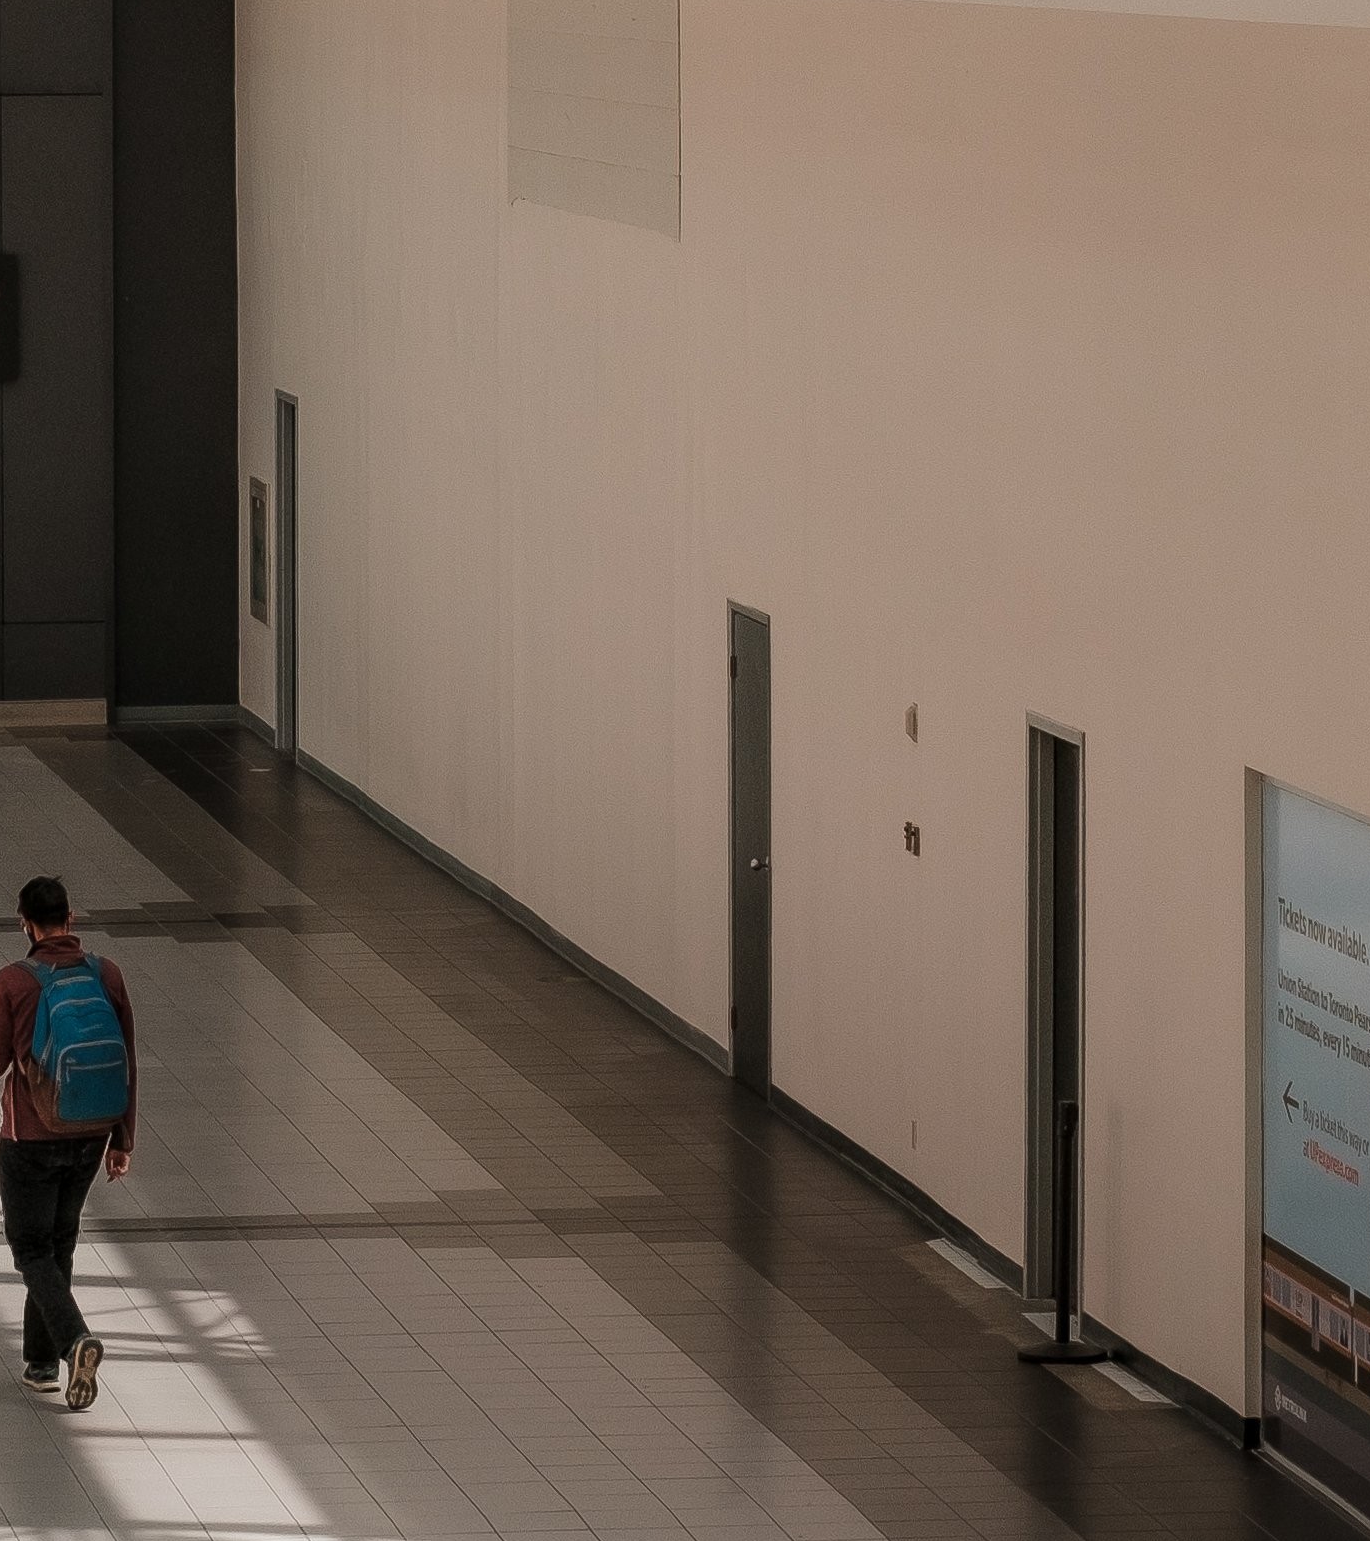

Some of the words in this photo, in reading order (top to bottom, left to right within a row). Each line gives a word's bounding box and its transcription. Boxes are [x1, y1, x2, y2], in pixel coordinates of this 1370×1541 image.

[1277, 897, 1307, 936] Tickets
[1307, 918, 1327, 944] now
[1327, 925, 1370, 966] available.
[1277, 969, 1297, 995] Union
[1297, 977, 1320, 1008] Station
[1320, 991, 1328, 1011] to
[1328, 992, 1354, 1023] Toronto
[1277, 1001, 1285, 1024] in
[1285, 1005, 1294, 1029] 25
[1322, 1031, 1341, 1058] every
[1342, 1034, 1350, 1057] 15
[1302, 1100, 1315, 1131] Buy
[1320, 1110, 1337, 1140] ticket
[1337, 1119, 1348, 1144] this
[1349, 1131, 1362, 1158] way
[1302, 1138, 1310, 1158] at
